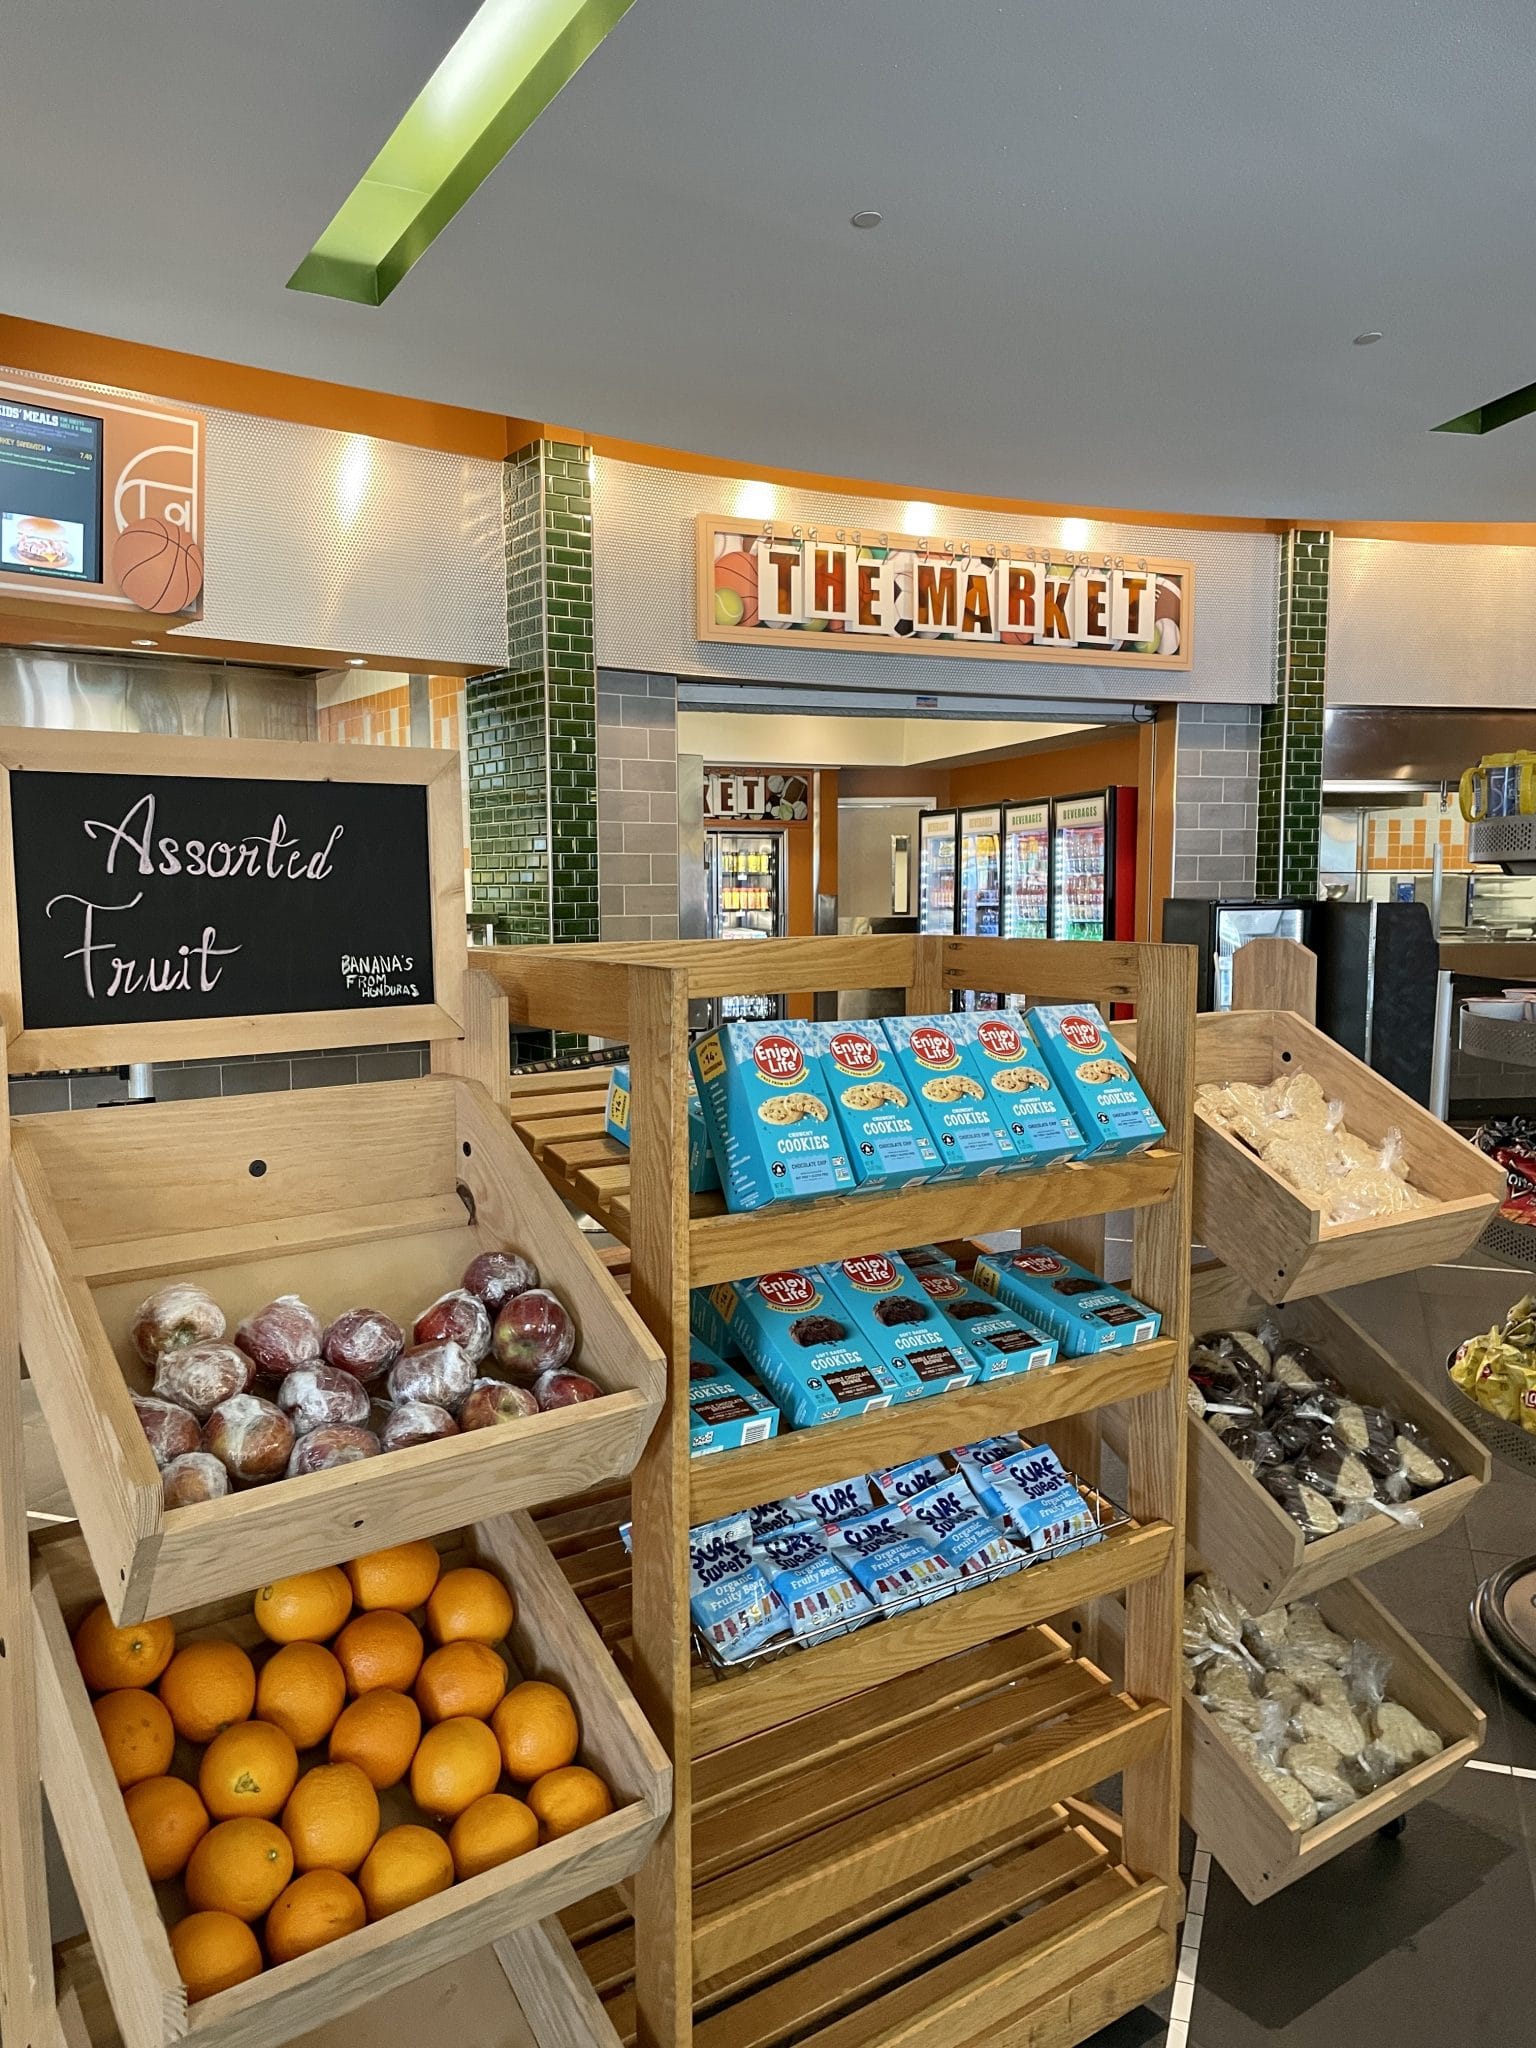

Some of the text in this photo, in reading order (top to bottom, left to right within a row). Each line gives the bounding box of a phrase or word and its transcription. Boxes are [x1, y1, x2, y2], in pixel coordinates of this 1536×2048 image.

[23, 409, 59, 427] MEALS
[768, 549, 1148, 640] THE MARKET
[1012, 813, 1043, 826] BEVERAGES
[1063, 806, 1097, 820] BEVERAGES
[84, 793, 344, 880] Assorted
[46, 892, 242, 999] Fruit
[341, 954, 414, 975] BANANA'S
[345, 973, 387, 989] FROM
[362, 984, 420, 998] HONDURAS
[979, 1027, 1015, 1042] Enjoy
[1061, 1021, 1095, 1036] Enjoy
[831, 1039, 872, 1056] Enjoy
[911, 1033, 949, 1050] Enjoy
[991, 1038, 1016, 1052] Life
[1073, 1033, 1096, 1045] Life
[755, 1043, 800, 1062] Enjoy
[844, 1051, 872, 1066] Life
[924, 1045, 950, 1059] Life
[768, 1057, 797, 1073] Life
[1097, 1091, 1138, 1106] COOKIES
[1012, 1101, 1057, 1117] COOKIES
[863, 1119, 913, 1136] COOKIES
[943, 1111, 991, 1127] COOKIES
[777, 1135, 830, 1154] COOKIES
[792, 1160, 817, 1170] CHOCOLATE
[843, 1257, 888, 1274] Enjoy
[860, 1268, 890, 1283] Life
[759, 1277, 806, 1294] Enjoy
[776, 1287, 809, 1303] Life
[971, 1320, 1017, 1335] COOKIES
[895, 1331, 944, 1350] COOKIES
[811, 1351, 862, 1371] COOKIES
[689, 1384, 736, 1401] OOKIES
[1010, 1456, 1055, 1487] SURF
[811, 1484, 859, 1519] SURF
[1041, 1489, 1072, 1506] Organic
[916, 1491, 964, 1526] SURF
[1039, 1500, 1065, 1518] Fruity
[844, 1517, 896, 1546] SURF
[951, 1521, 983, 1542] Organic
[764, 1531, 814, 1560] SURF
[874, 1542, 911, 1561] Organic
[951, 1534, 977, 1555] Fruity
[871, 1544, 927, 1572] Fruity Bears
[795, 1557, 830, 1577] Organic
[715, 1572, 754, 1596] Organic
[790, 1571, 820, 1591] Fruity
[710, 1589, 743, 1612] Fruity
